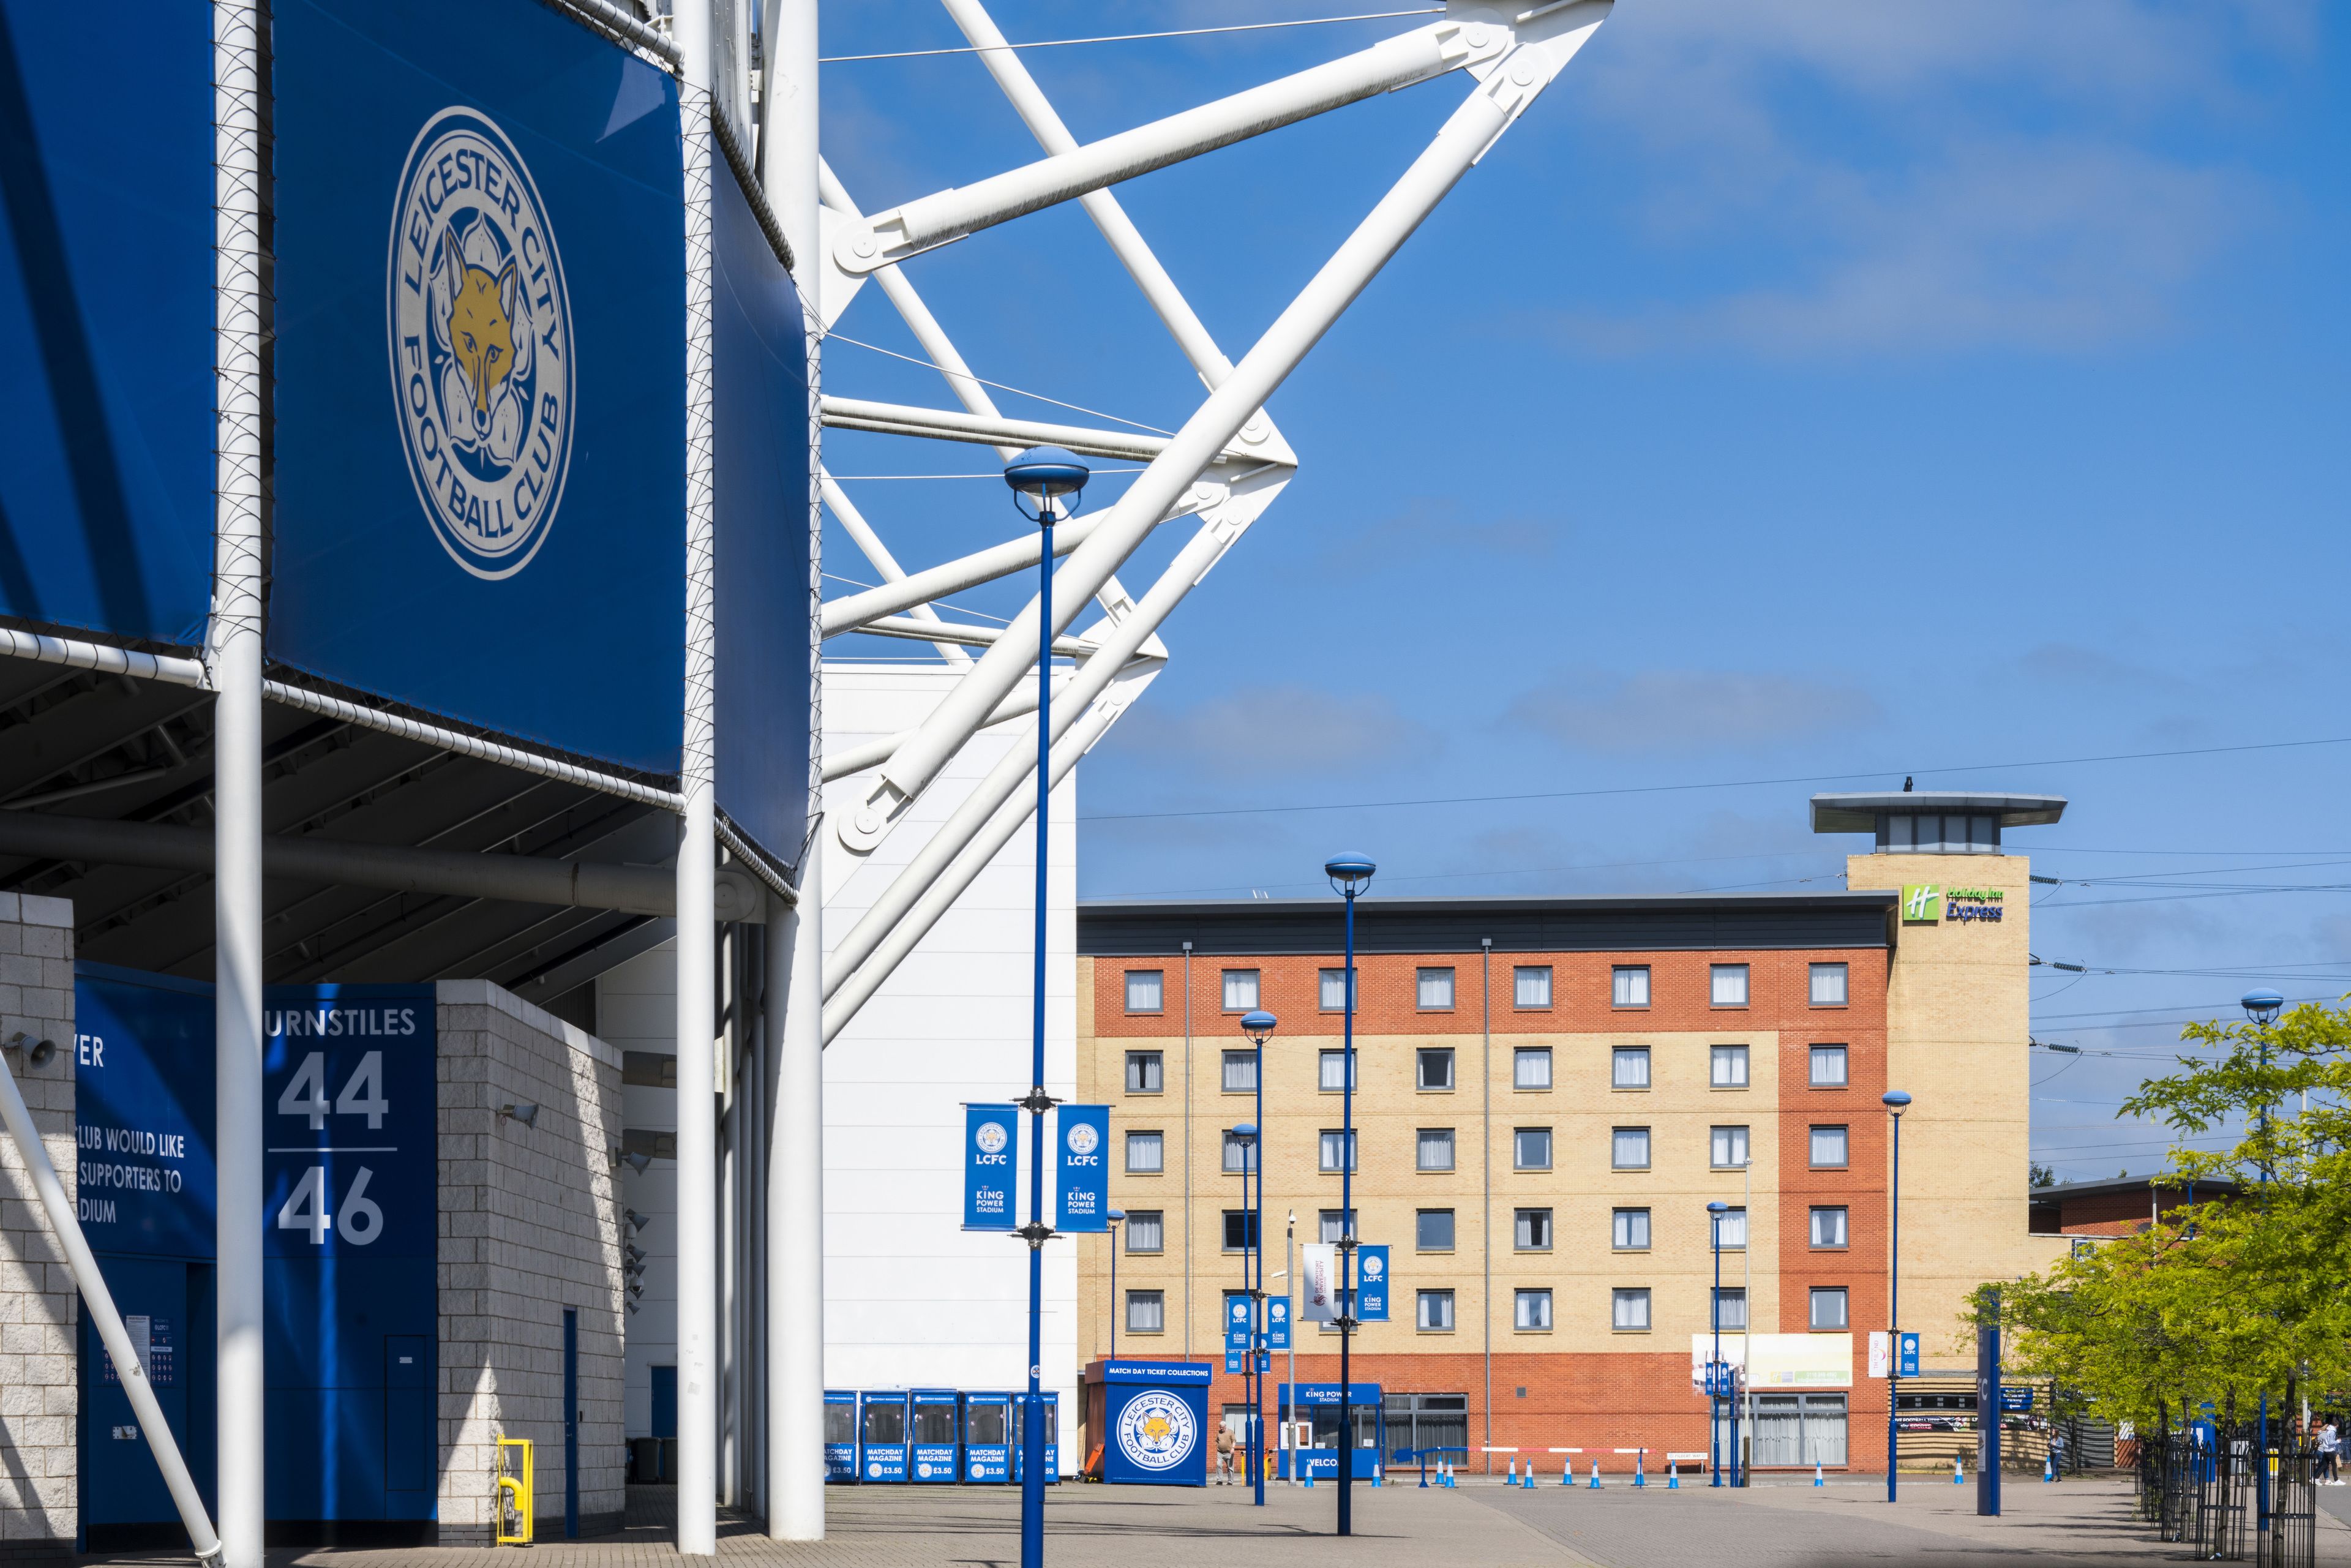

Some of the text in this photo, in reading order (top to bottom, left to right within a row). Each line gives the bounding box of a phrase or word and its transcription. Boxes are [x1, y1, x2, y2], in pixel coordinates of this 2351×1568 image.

[404, 148, 560, 362] LEICESTER CITY
[404, 334, 558, 538] FOOTBALL CLUB
[1947, 887, 2004, 900] Holiday Inn
[1946, 902, 2003, 921] Express
[264, 1008, 416, 1037] URNSTILES
[278, 1051, 389, 1130] 44
[75, 1125, 184, 1158] LUB WOULD LIKE
[976, 1154, 1007, 1165] LCFC
[1067, 1155, 1098, 1166] LCFC
[80, 1161, 181, 1193] SUPPORTERS TO
[278, 1166, 383, 1245] 46
[977, 1190, 1004, 1199] KING
[1068, 1191, 1095, 1201] KING
[1125, 1397, 1190, 1429] LEICESTER CITY
[1124, 1433, 1190, 1463] FOOTBALL CLUB
